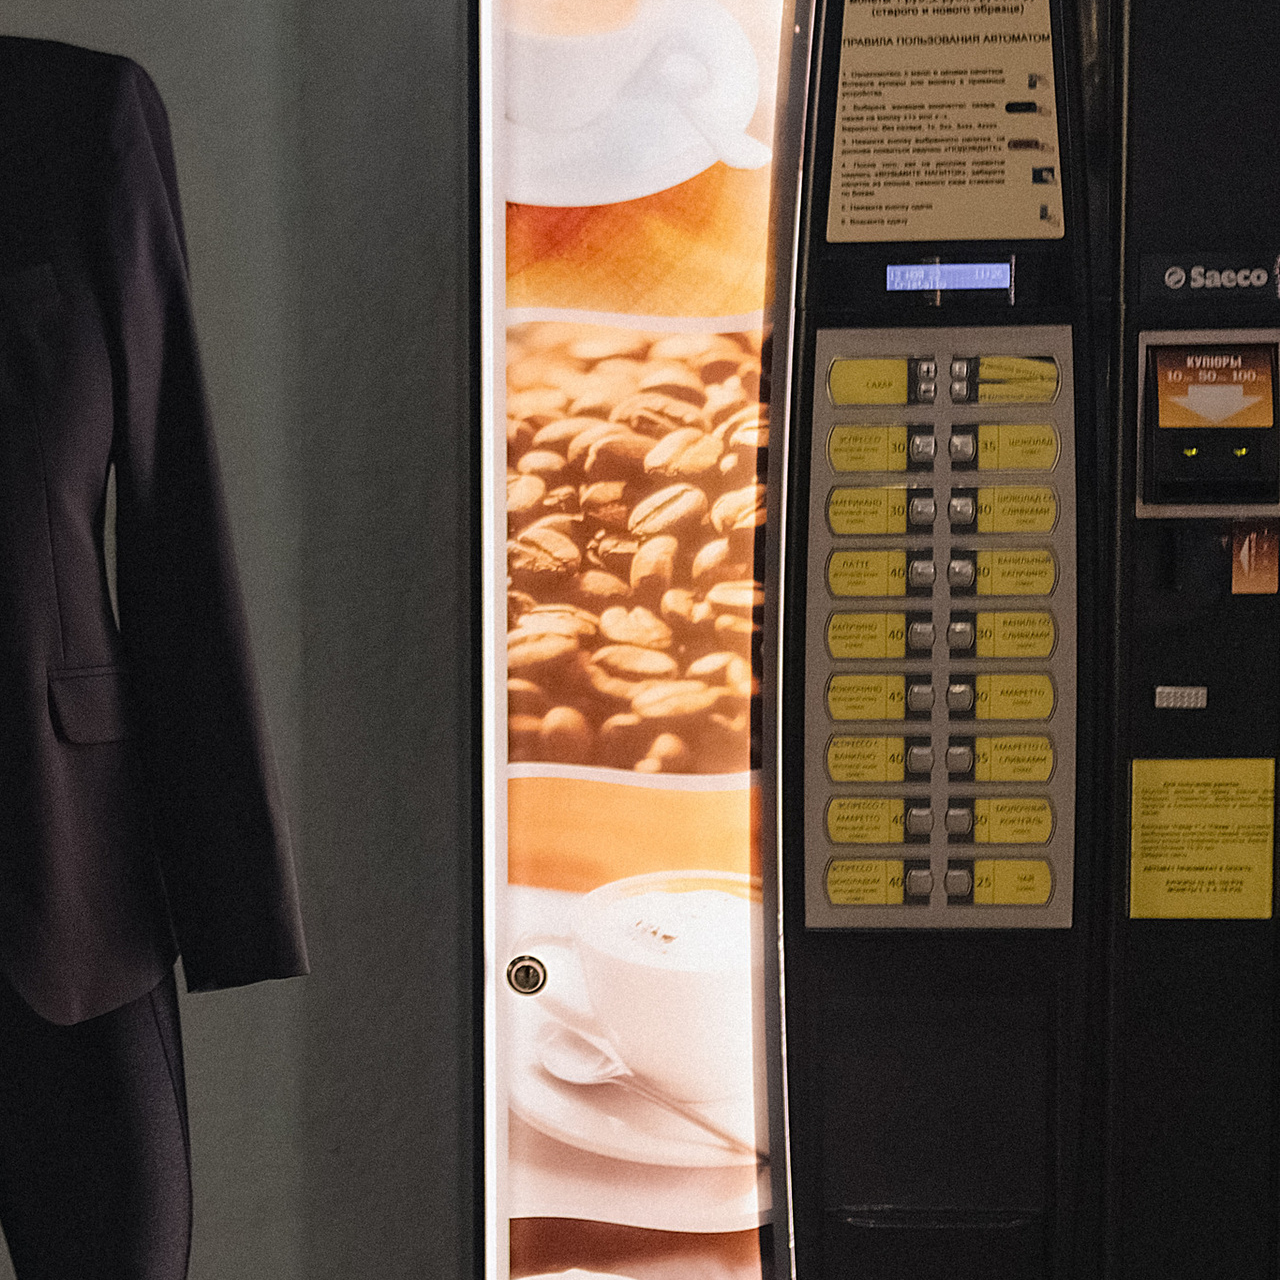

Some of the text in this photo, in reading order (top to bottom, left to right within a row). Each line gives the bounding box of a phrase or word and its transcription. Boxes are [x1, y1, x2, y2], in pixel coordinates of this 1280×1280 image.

[843, 33, 1051, 48] ПРАВИЛА ПОЛЬЗОВАНИЯ АВТОМАТОМ
[1190, 265, 1269, 289] Saeco
[1186, 355, 1242, 369] КУПЮРЫ
[1167, 370, 1183, 382] 10
[1232, 369, 1257, 382] 100
[888, 629, 904, 641] 40
[888, 753, 904, 764] 40
